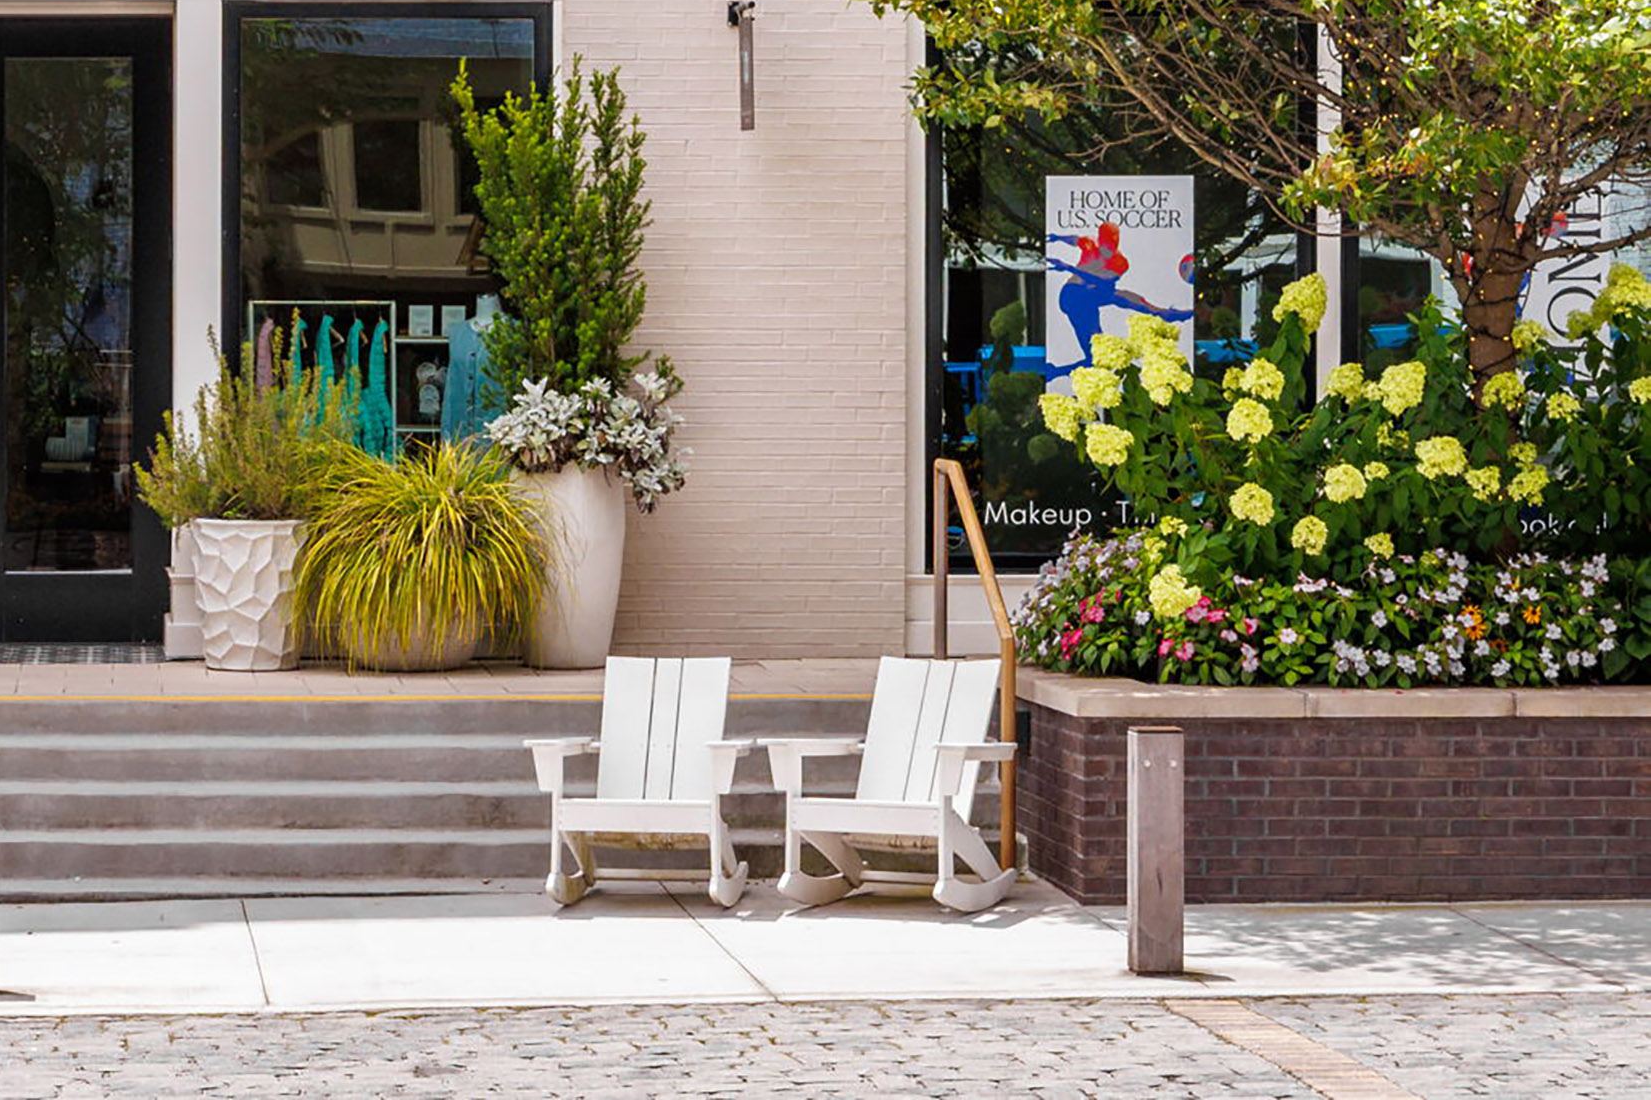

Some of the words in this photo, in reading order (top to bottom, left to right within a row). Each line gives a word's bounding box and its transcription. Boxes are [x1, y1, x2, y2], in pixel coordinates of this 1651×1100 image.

[1070, 190, 1136, 210] HOME
[1139, 190, 1170, 210] OF
[1057, 210, 1090, 229] U.S.
[1094, 209, 1182, 229] SOCCER
[983, 501, 1092, 529] Makeup
